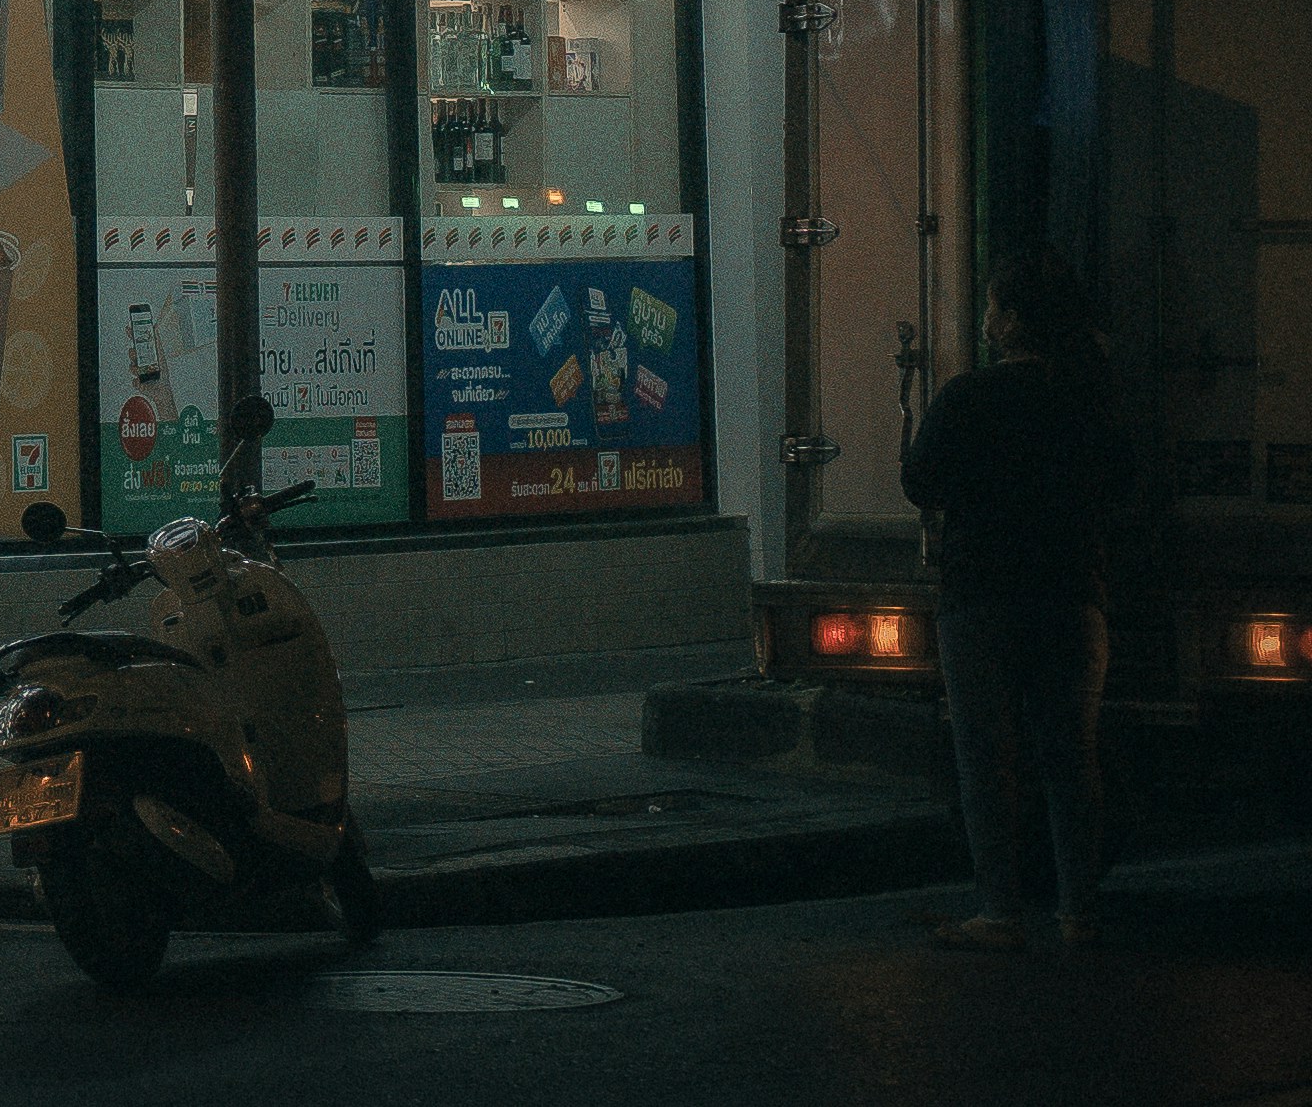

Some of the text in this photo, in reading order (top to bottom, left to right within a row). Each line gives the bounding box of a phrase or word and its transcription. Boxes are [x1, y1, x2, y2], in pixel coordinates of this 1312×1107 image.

[277, 306, 341, 332] Delivery
[435, 289, 484, 326] ALL
[436, 328, 485, 350] ONLINE
[527, 428, 572, 451] 10,000
[551, 466, 576, 495] 24
